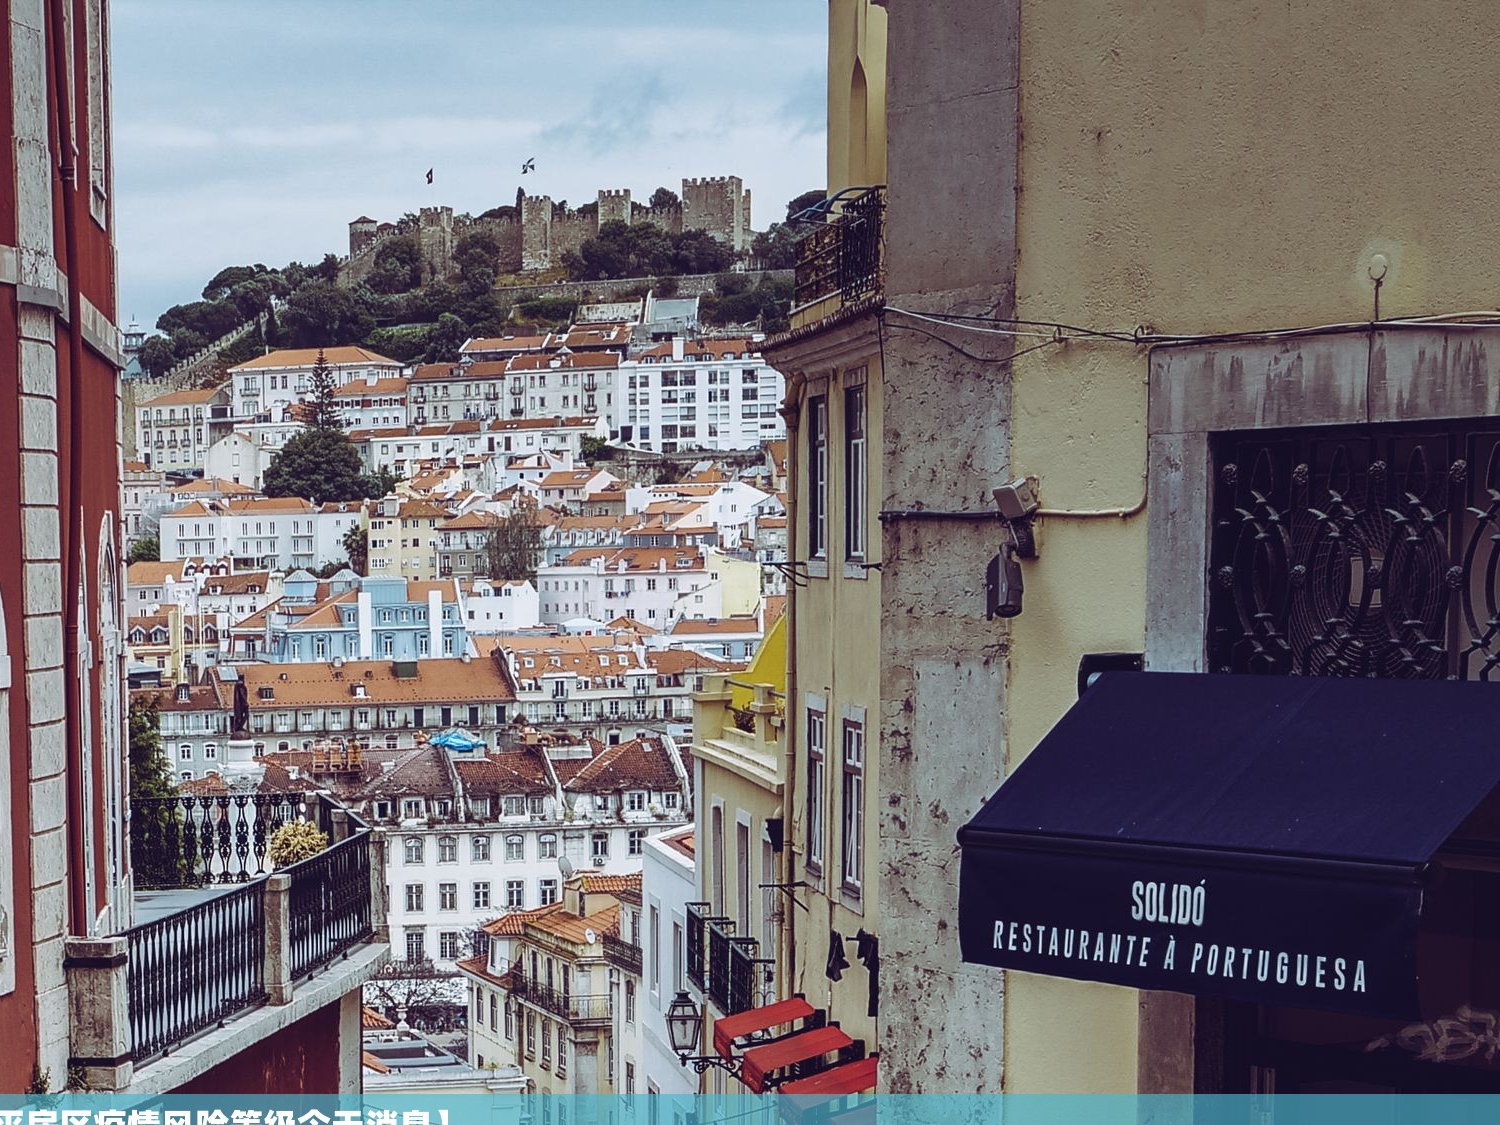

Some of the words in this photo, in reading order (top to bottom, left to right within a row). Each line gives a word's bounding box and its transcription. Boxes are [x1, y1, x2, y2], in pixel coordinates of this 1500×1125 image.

[1132, 879, 1206, 926] SOLIDÓ
[993, 920, 1149, 967] RESTAURANTE
[1163, 935, 1176, 970] À
[1191, 942, 1367, 992] PORTUGUESA
